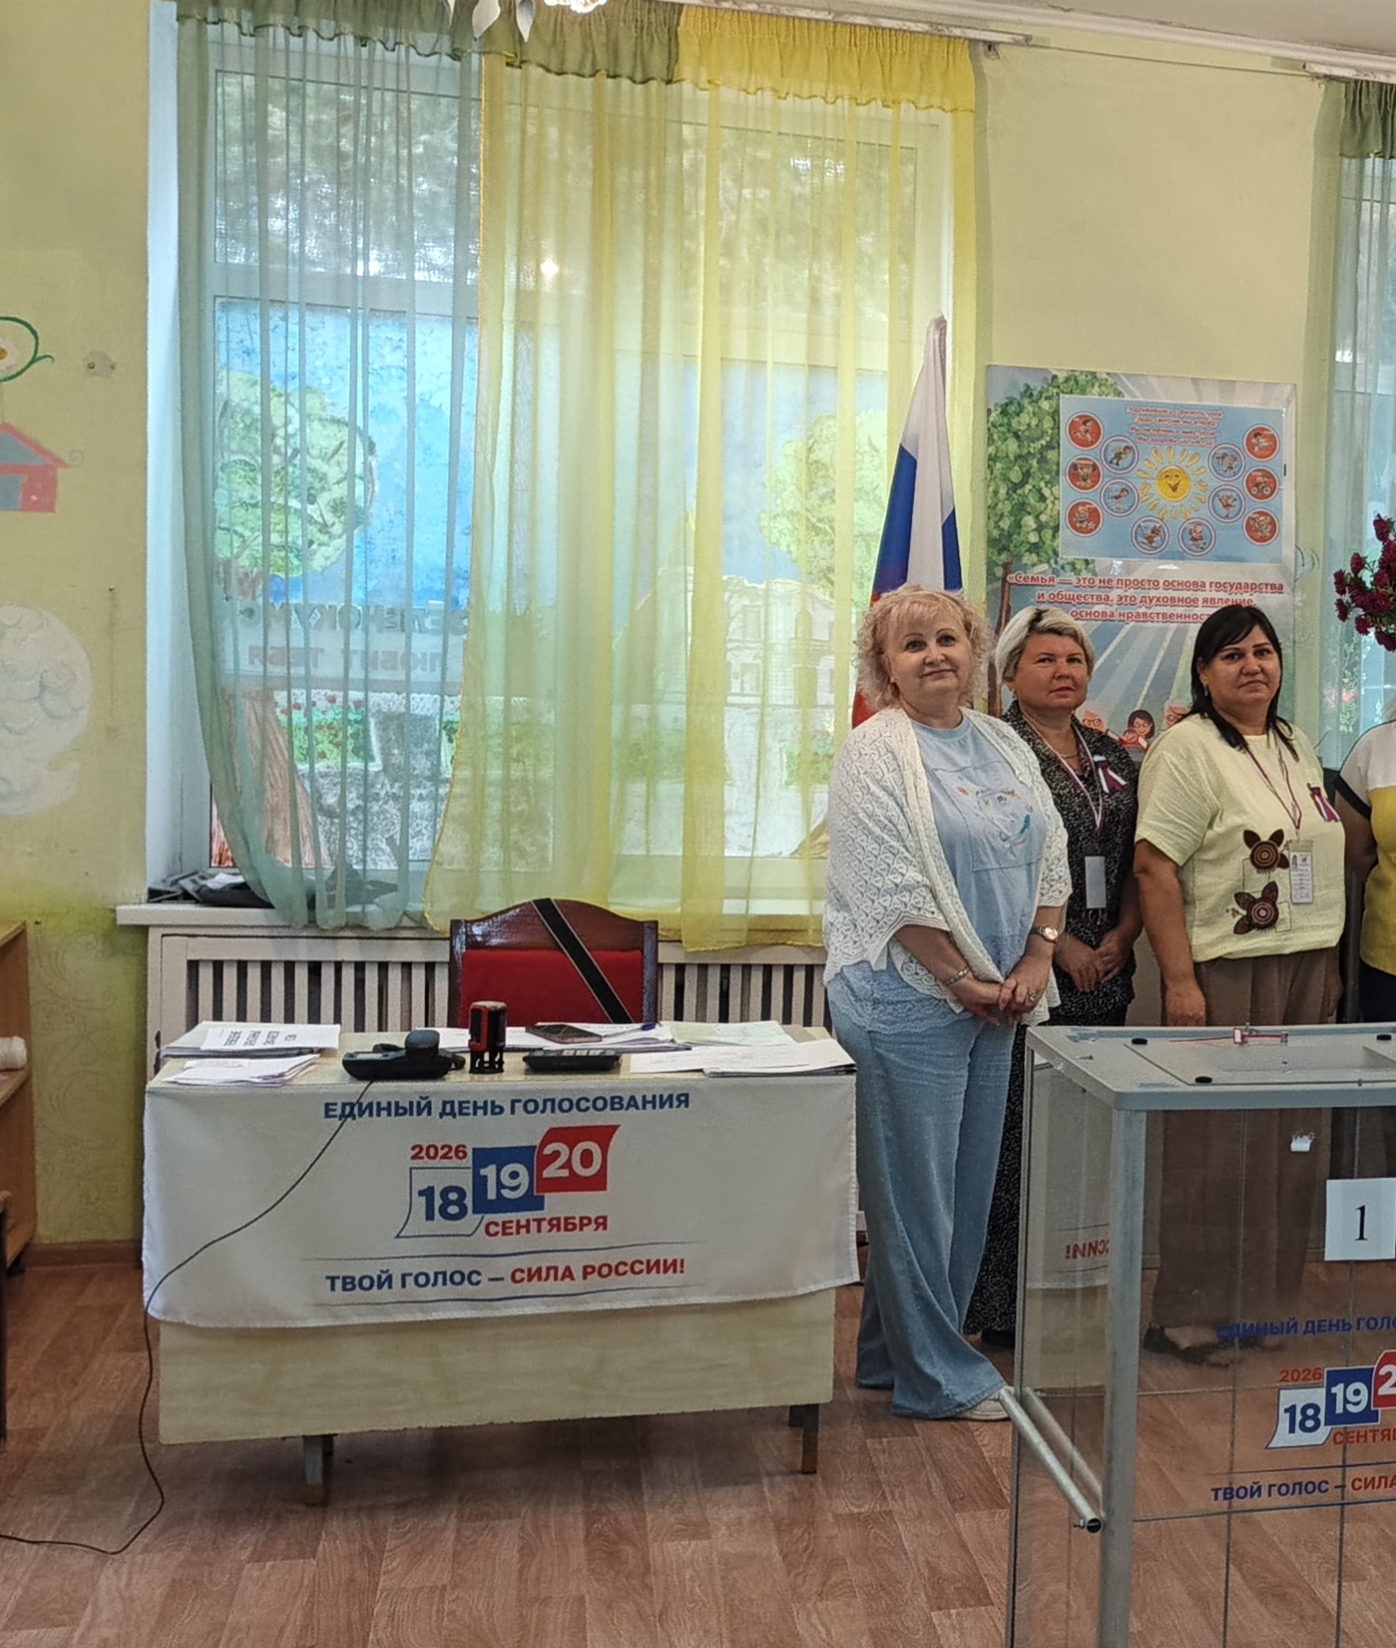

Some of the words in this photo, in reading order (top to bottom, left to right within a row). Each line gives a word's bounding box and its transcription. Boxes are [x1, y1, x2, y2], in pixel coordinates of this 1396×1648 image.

[1007, 573, 1055, 583] «Семья
[1075, 577, 1095, 585] это
[1099, 578, 1114, 586] не
[1117, 578, 1160, 588] просто
[1162, 580, 1206, 589] основа
[1209, 581, 1284, 593] государства
[1037, 592, 1045, 600] и
[1048, 590, 1113, 604] общества,
[1116, 594, 1137, 603] это
[1140, 595, 1199, 606] духовное
[1070, 610, 1114, 618] основа
[323, 1096, 432, 1121] ЕДИНЫЙ
[439, 1099, 505, 1118] ДЕНЬ
[510, 1093, 690, 1115] ГОЛОСОВАНИЯ
[410, 1144, 468, 1160] 2026
[542, 1141, 603, 1178] 20
[480, 1163, 530, 1199] 19
[418, 1185, 468, 1221] 18
[484, 1215, 608, 1237] СЕНТЯБРЯ
[1355, 1204, 1368, 1241] 1
[325, 1269, 393, 1292] ТВОЙ
[401, 1270, 482, 1288] ГОЛОС
[510, 1265, 575, 1284] СИЛА
[582, 1258, 685, 1280] РОССИИ!
[1216, 1317, 1298, 1340] ЕДИНЫЙ
[1303, 1319, 1352, 1335] ДЕНЬ
[1280, 1368, 1322, 1382] 2026
[1331, 1382, 1368, 1414] 19
[1284, 1403, 1321, 1434] 18
[1211, 1481, 1261, 1501] ТВОЙ
[1267, 1480, 1329, 1498] ГОЛОС
